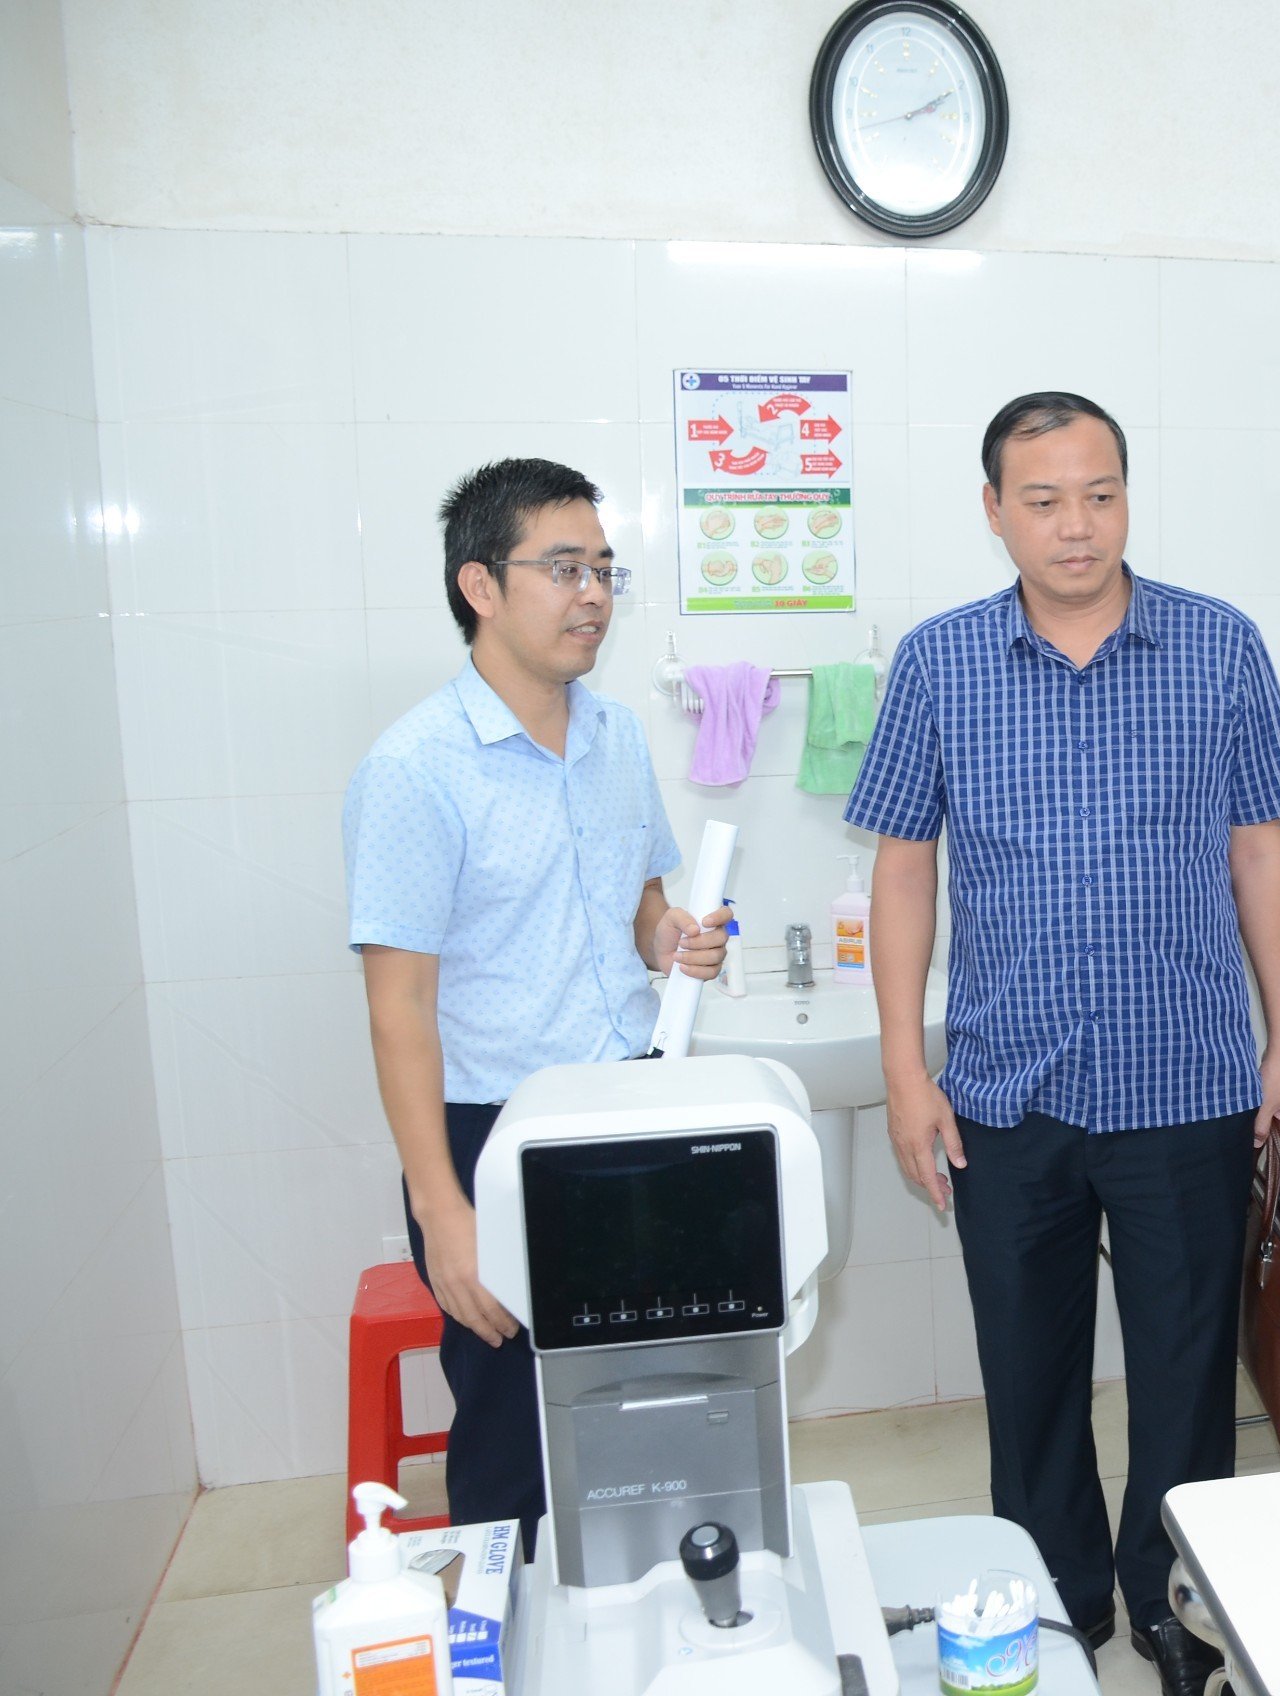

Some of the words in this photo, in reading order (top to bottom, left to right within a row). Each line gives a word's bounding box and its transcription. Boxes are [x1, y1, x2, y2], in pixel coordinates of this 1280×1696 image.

[766, 404, 778, 415] 2
[690, 424, 698, 438] 1
[802, 422, 810, 437] 4
[714, 452, 725, 467] 3
[804, 457, 813, 471] 5
[706, 492, 721, 502] QUY
[723, 491, 745, 501] TRÌNH
[764, 492, 777, 501] TAY
[813, 492, 830, 502] QUY
[691, 1143, 742, 1154] SHIN-NIPPON
[587, 1484, 646, 1500] ACCUREF
[652, 1480, 687, 1493] K-900
[492, 1525, 511, 1540] HM
[486, 1540, 508, 1576] GLOVE
